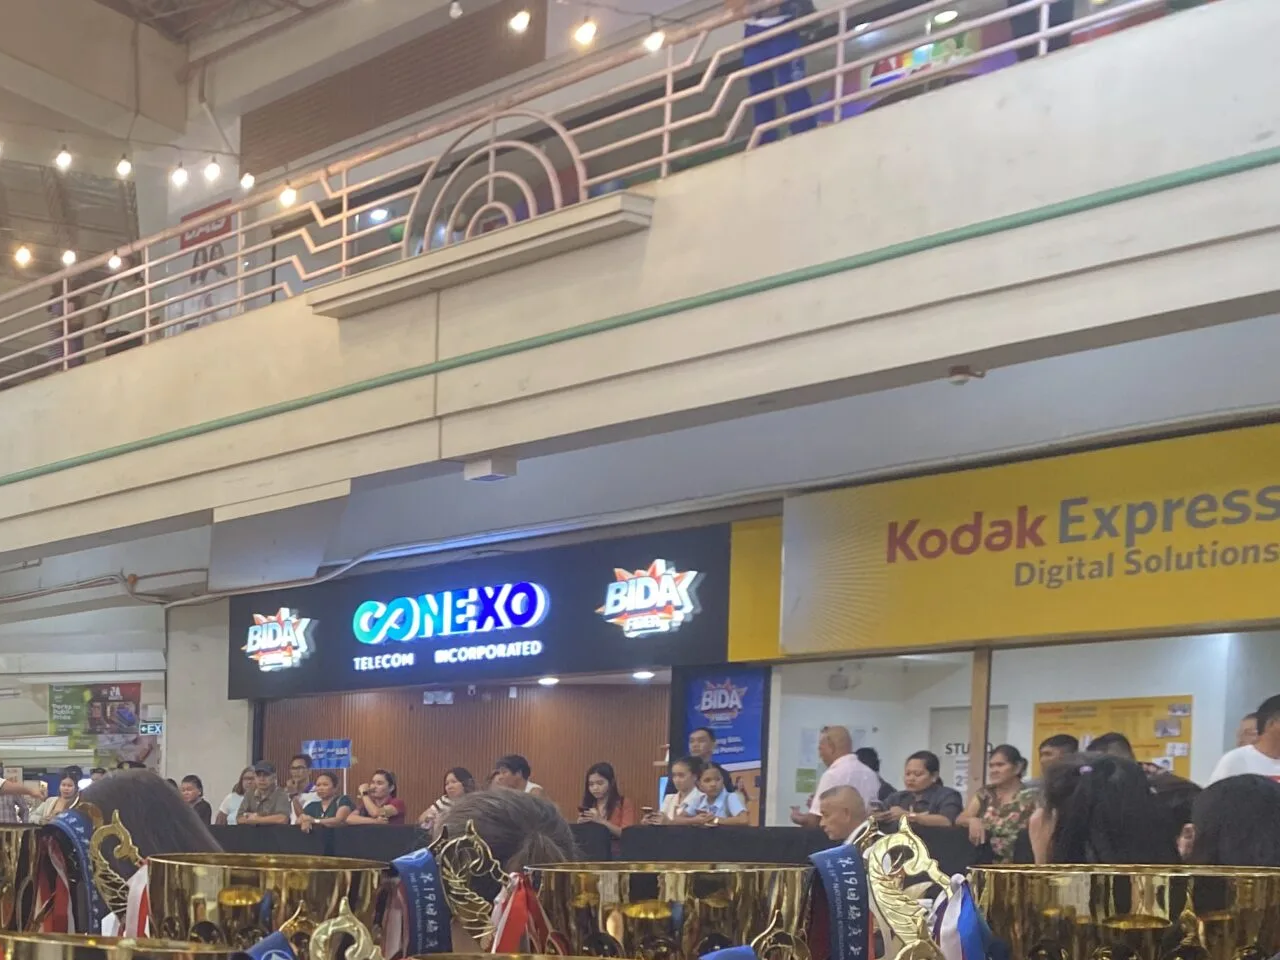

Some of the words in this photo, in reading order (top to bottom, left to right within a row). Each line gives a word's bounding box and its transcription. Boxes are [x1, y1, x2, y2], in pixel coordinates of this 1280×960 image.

[886, 506, 1048, 564] Kodak
[1059, 484, 1280, 547] Express
[1014, 553, 1115, 589] Digital
[1124, 541, 1280, 576] Solutions
[353, 581, 549, 644] CONEXO
[603, 573, 683, 617] BIDA
[247, 619, 298, 653] BIDA
[353, 653, 414, 670] TELECOM
[434, 640, 543, 664] INCORPORATED
[700, 688, 742, 712] BIDA
[945, 742, 993, 755] STUO
